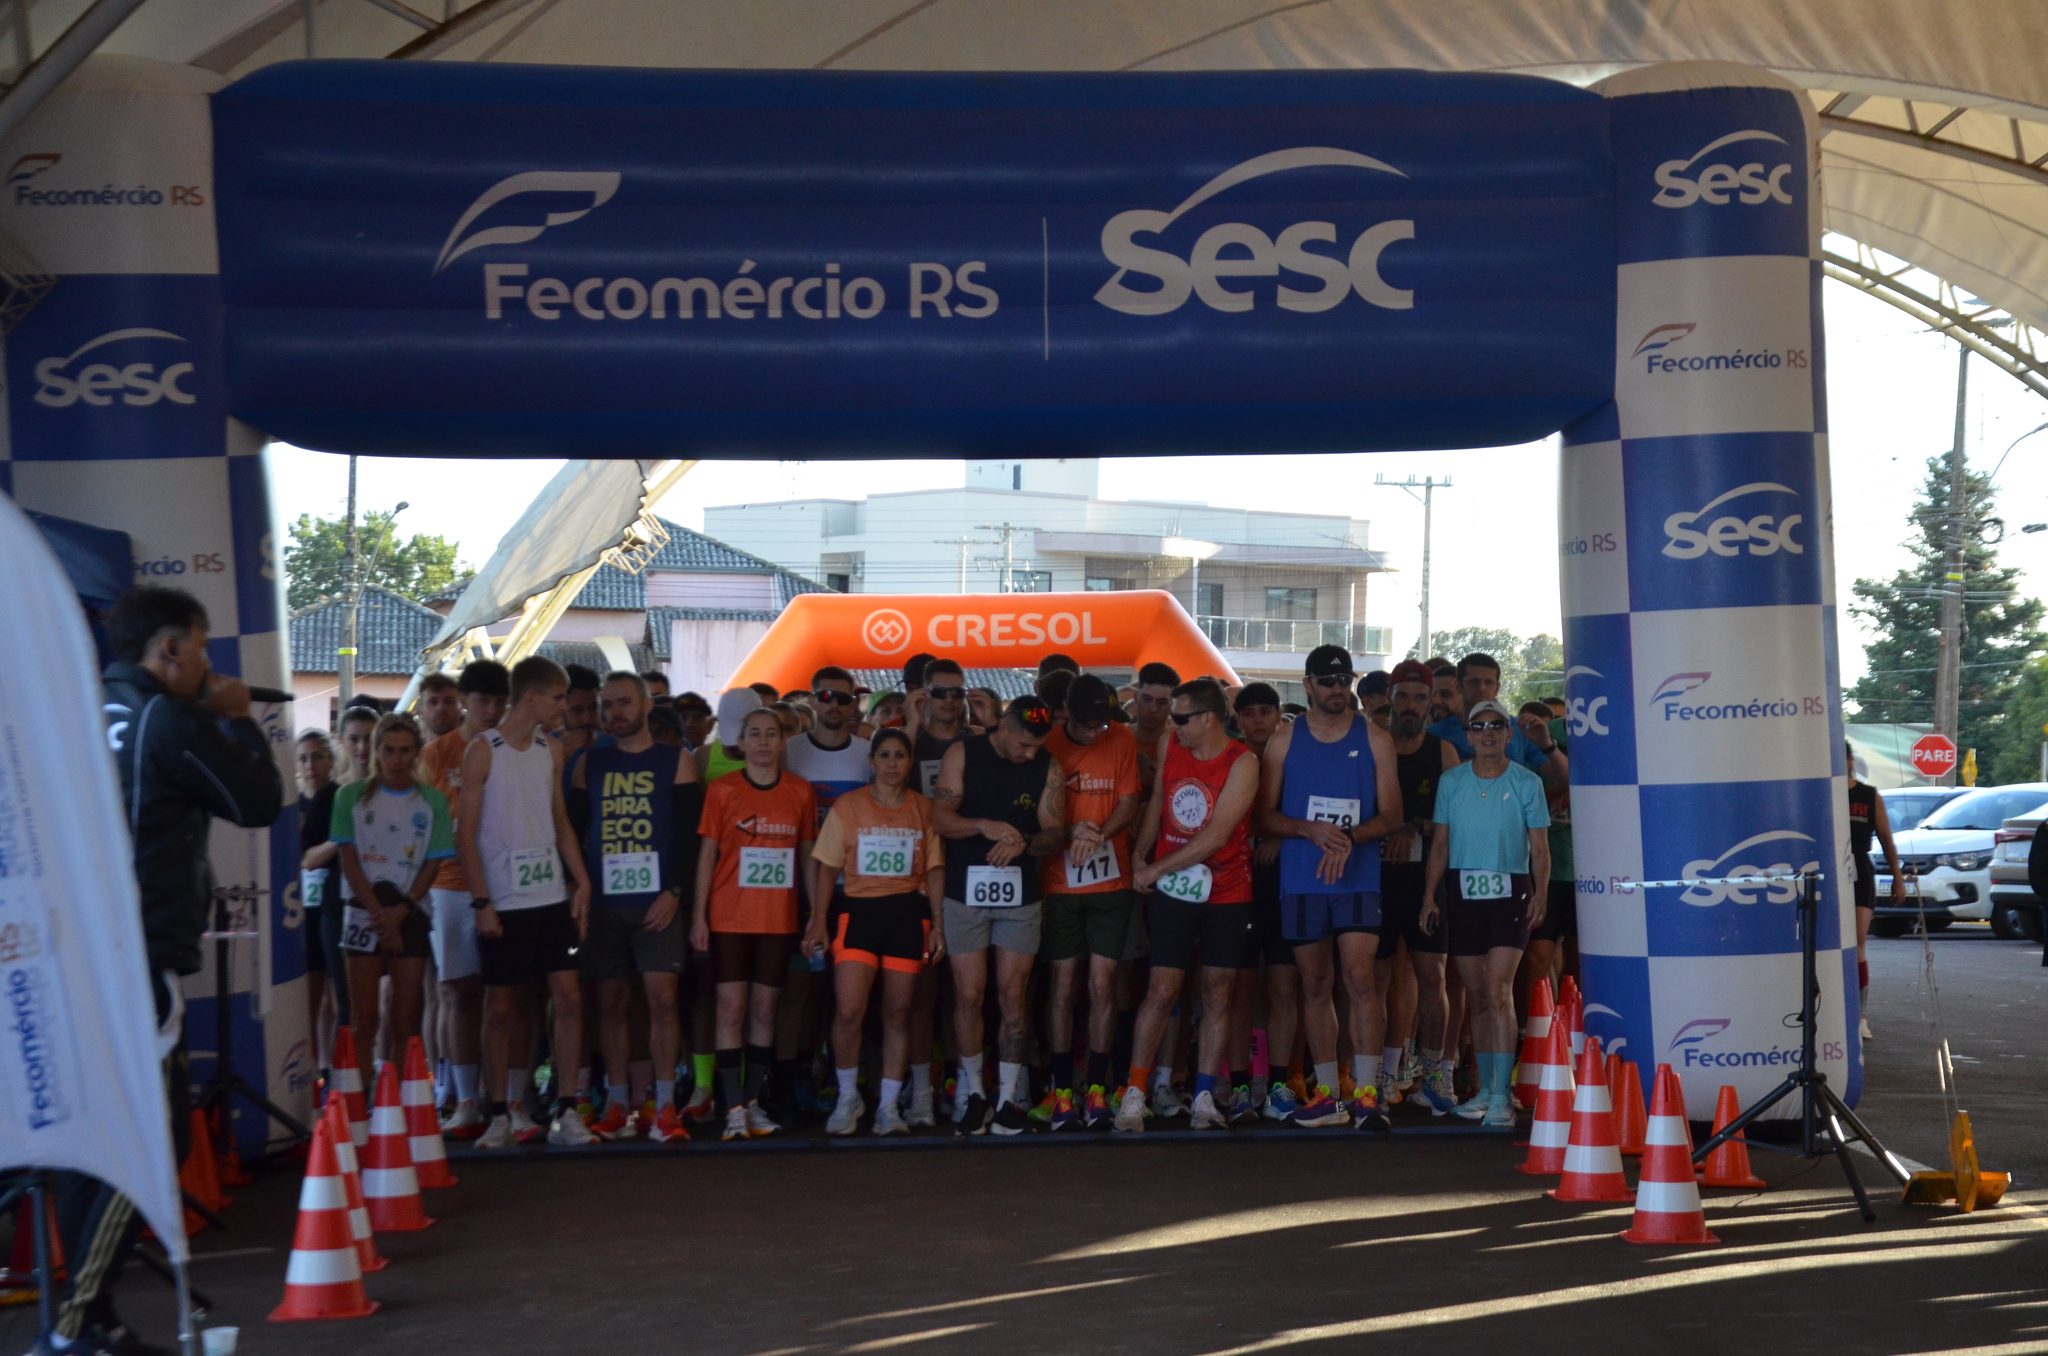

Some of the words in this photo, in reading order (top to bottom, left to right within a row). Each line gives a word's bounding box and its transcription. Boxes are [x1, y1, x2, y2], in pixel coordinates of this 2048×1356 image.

[16, 184, 163, 205] Fecomércio
[171, 185, 204, 206] RS
[484, 258, 886, 320] Fecomércio
[909, 260, 1000, 319] RS
[1647, 349, 1781, 374] Fecomércio
[1787, 349, 1808, 369] RS
[1592, 532, 1617, 552] RS
[193, 552, 225, 573] RS
[927, 611, 1108, 648] CRESOL
[1664, 698, 1798, 721] Fecomércio
[1803, 696, 1824, 715] RS
[1914, 749, 1954, 762] PARE
[602, 770, 655, 797] INS
[601, 797, 653, 817] PIRA
[601, 817, 653, 841] ECO
[519, 861, 555, 886] 244
[747, 862, 787, 884] 226
[864, 851, 906, 873] 268
[610, 868, 652, 890] 289
[1163, 871, 1204, 900] 334
[1466, 874, 1504, 897] 283
[974, 881, 1015, 903] 689
[1684, 1044, 1806, 1067] Fecomérc
[1823, 1041, 1844, 1061] RS
